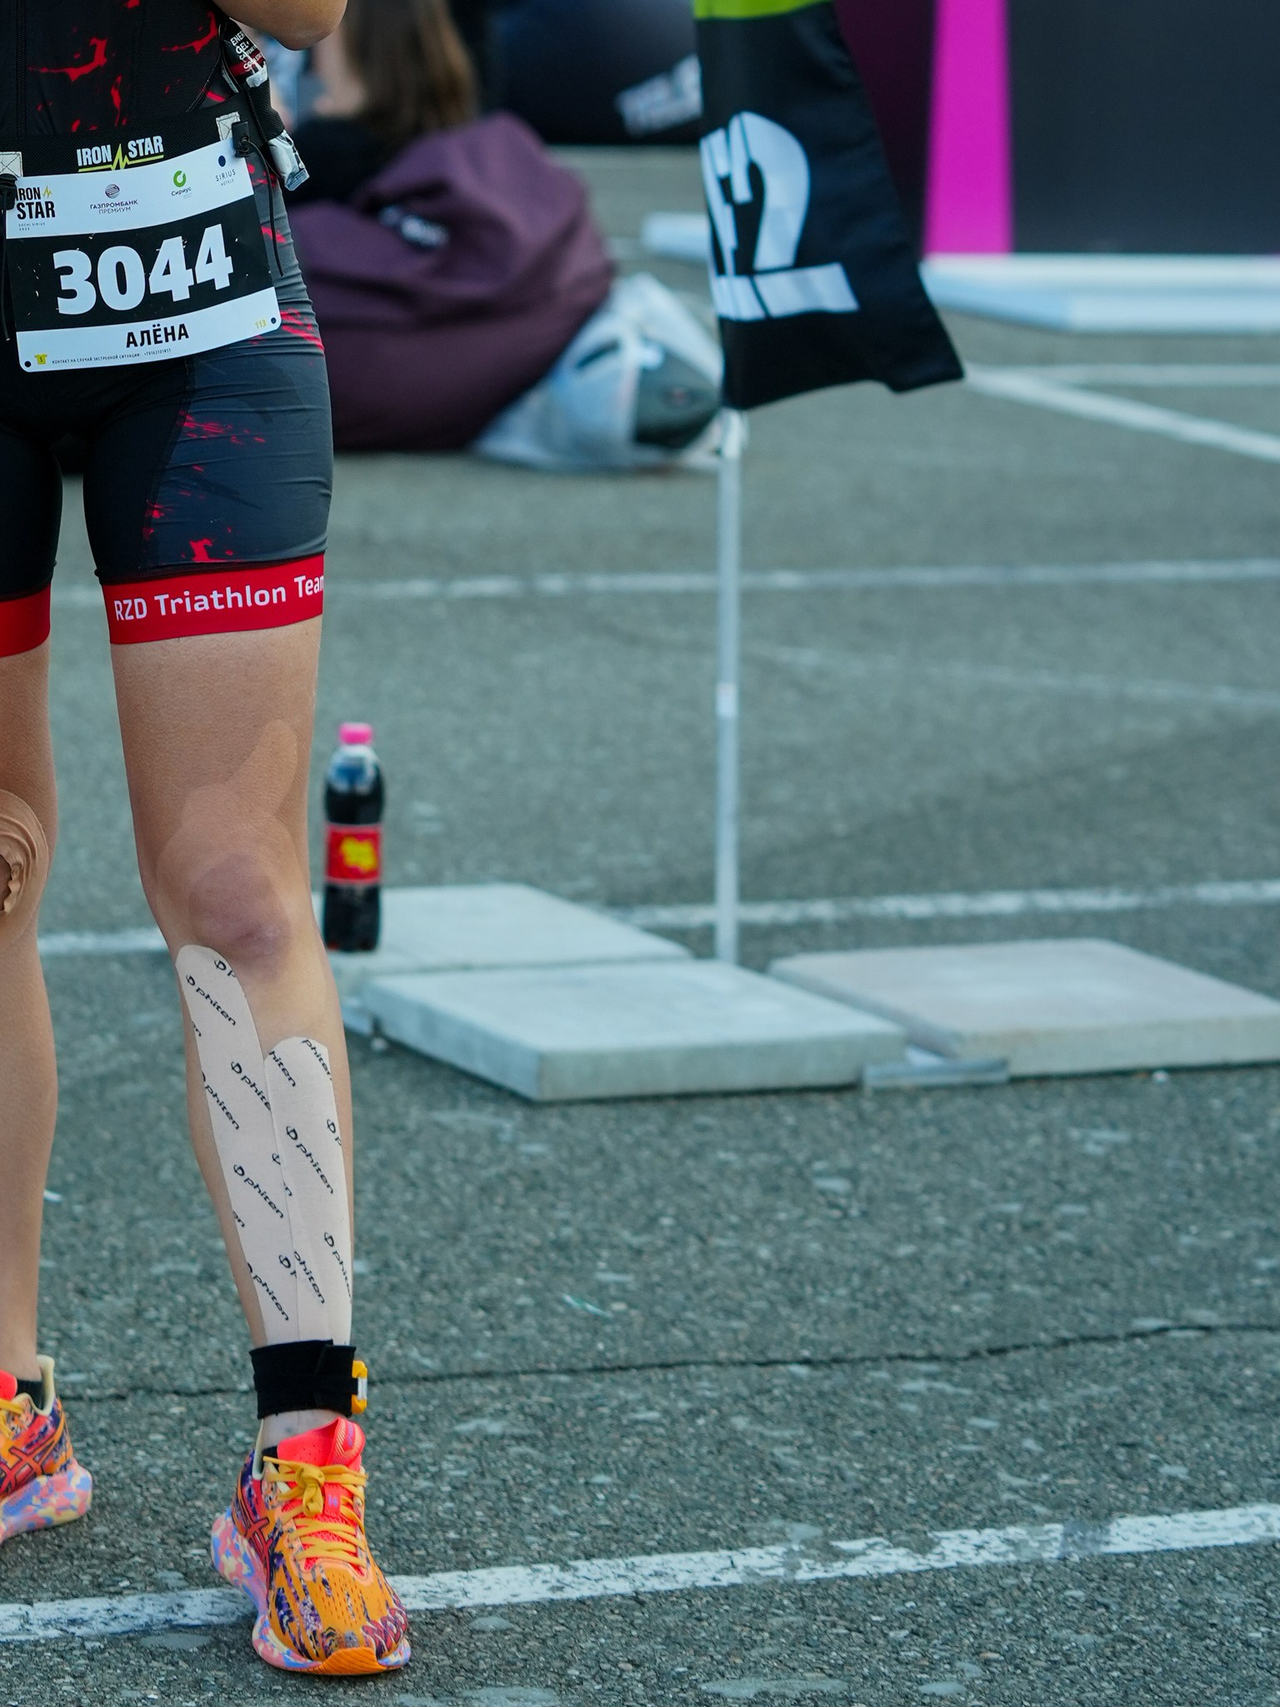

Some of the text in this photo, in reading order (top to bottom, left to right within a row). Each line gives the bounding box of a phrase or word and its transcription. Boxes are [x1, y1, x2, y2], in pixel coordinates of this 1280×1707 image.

[77, 135, 164, 166] IRON STAR
[15, 186, 42, 201] IRON
[215, 169, 236, 182] SIRIUS
[16, 201, 55, 220] STAR
[90, 199, 138, 210] ГАЗПРОМБАНК
[98, 206, 131, 214] ПРЕМИУМ
[52, 223, 234, 315] 3044
[125, 323, 190, 348] АЛЁНА
[254, 320, 267, 329] 113
[114, 598, 147, 621] RZD
[154, 585, 286, 616] Triathlon
[196, 987, 236, 1026] phiten
[268, 1050, 296, 1087] hiten
[205, 1085, 240, 1130] phiten
[241, 1075, 271, 1112] phite
[296, 1143, 334, 1194] phiten
[244, 1177, 284, 1219] phiten
[253, 1274, 289, 1321] phiten
